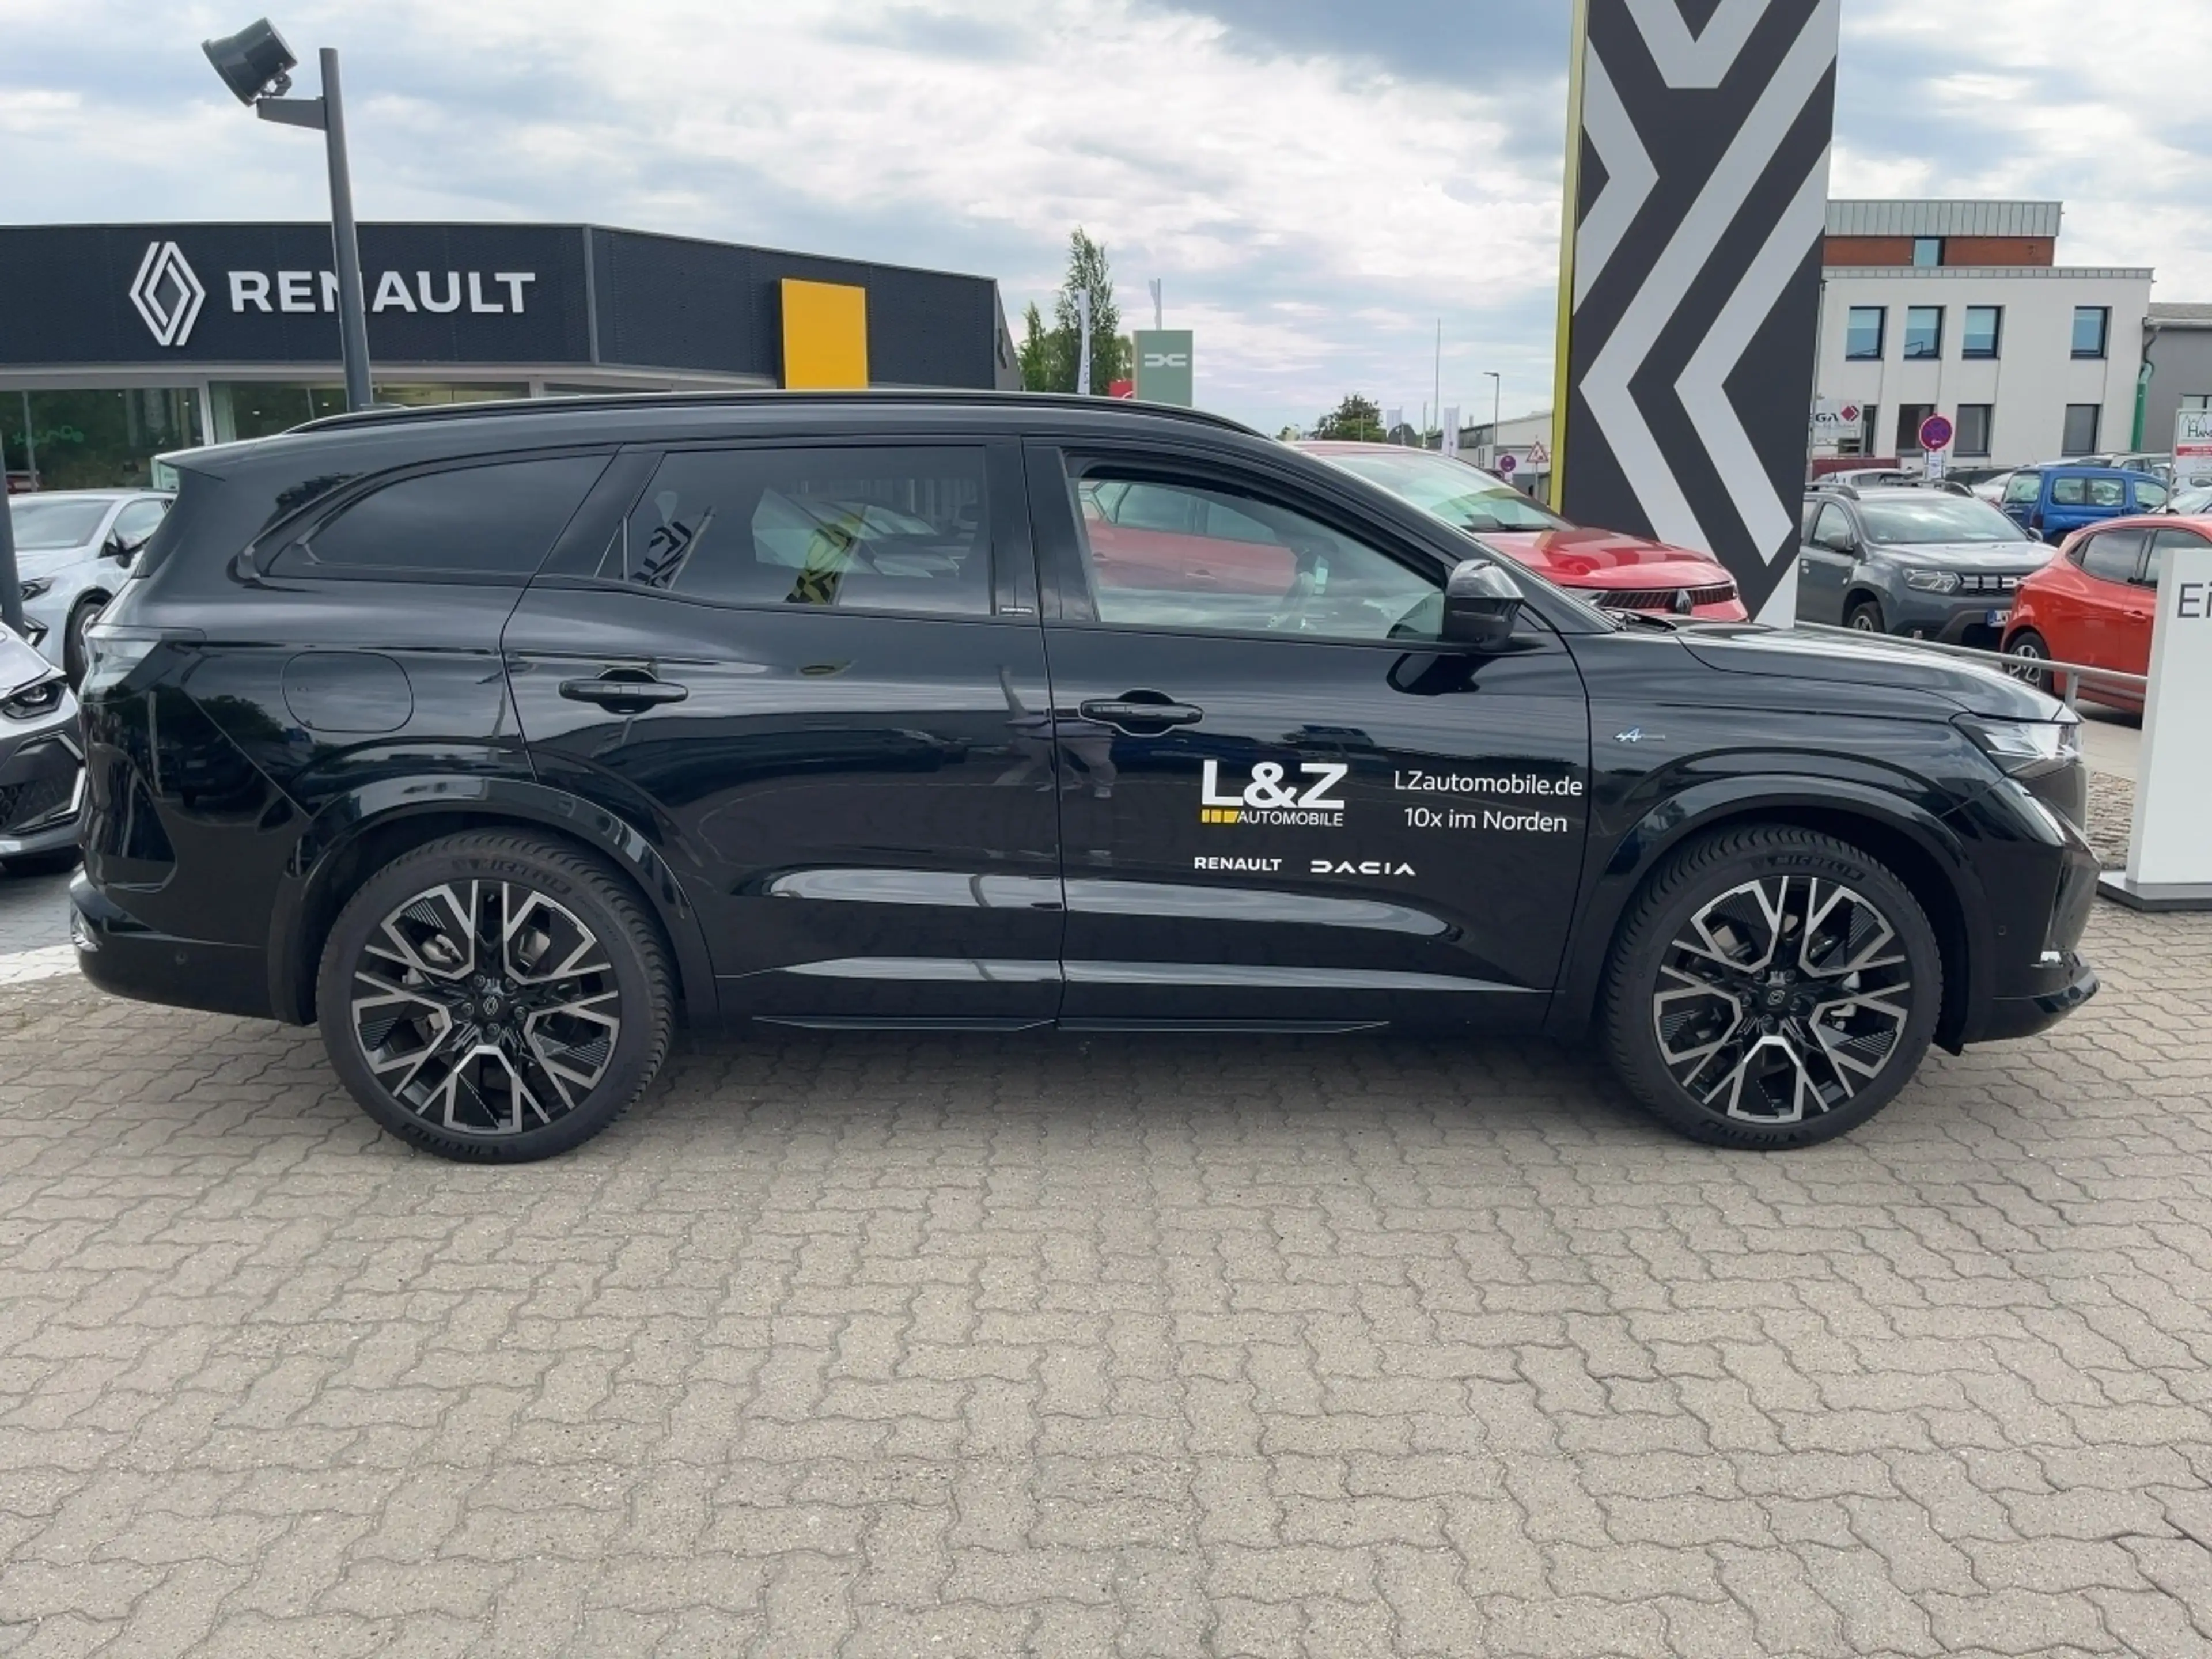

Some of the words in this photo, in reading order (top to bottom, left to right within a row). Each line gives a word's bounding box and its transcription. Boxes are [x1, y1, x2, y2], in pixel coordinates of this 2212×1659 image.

[1202, 759, 1349, 810] L&Z
[1395, 770, 1583, 796] LZautomobile.de
[1236, 810, 1344, 827] AUTOMOBILE
[1404, 807, 1442, 828] 10x
[1448, 809, 1476, 828] im
[1483, 810, 1568, 832] Norden
[1194, 857, 1282, 872] RENAULT
[1310, 860, 1416, 876] DACIA
